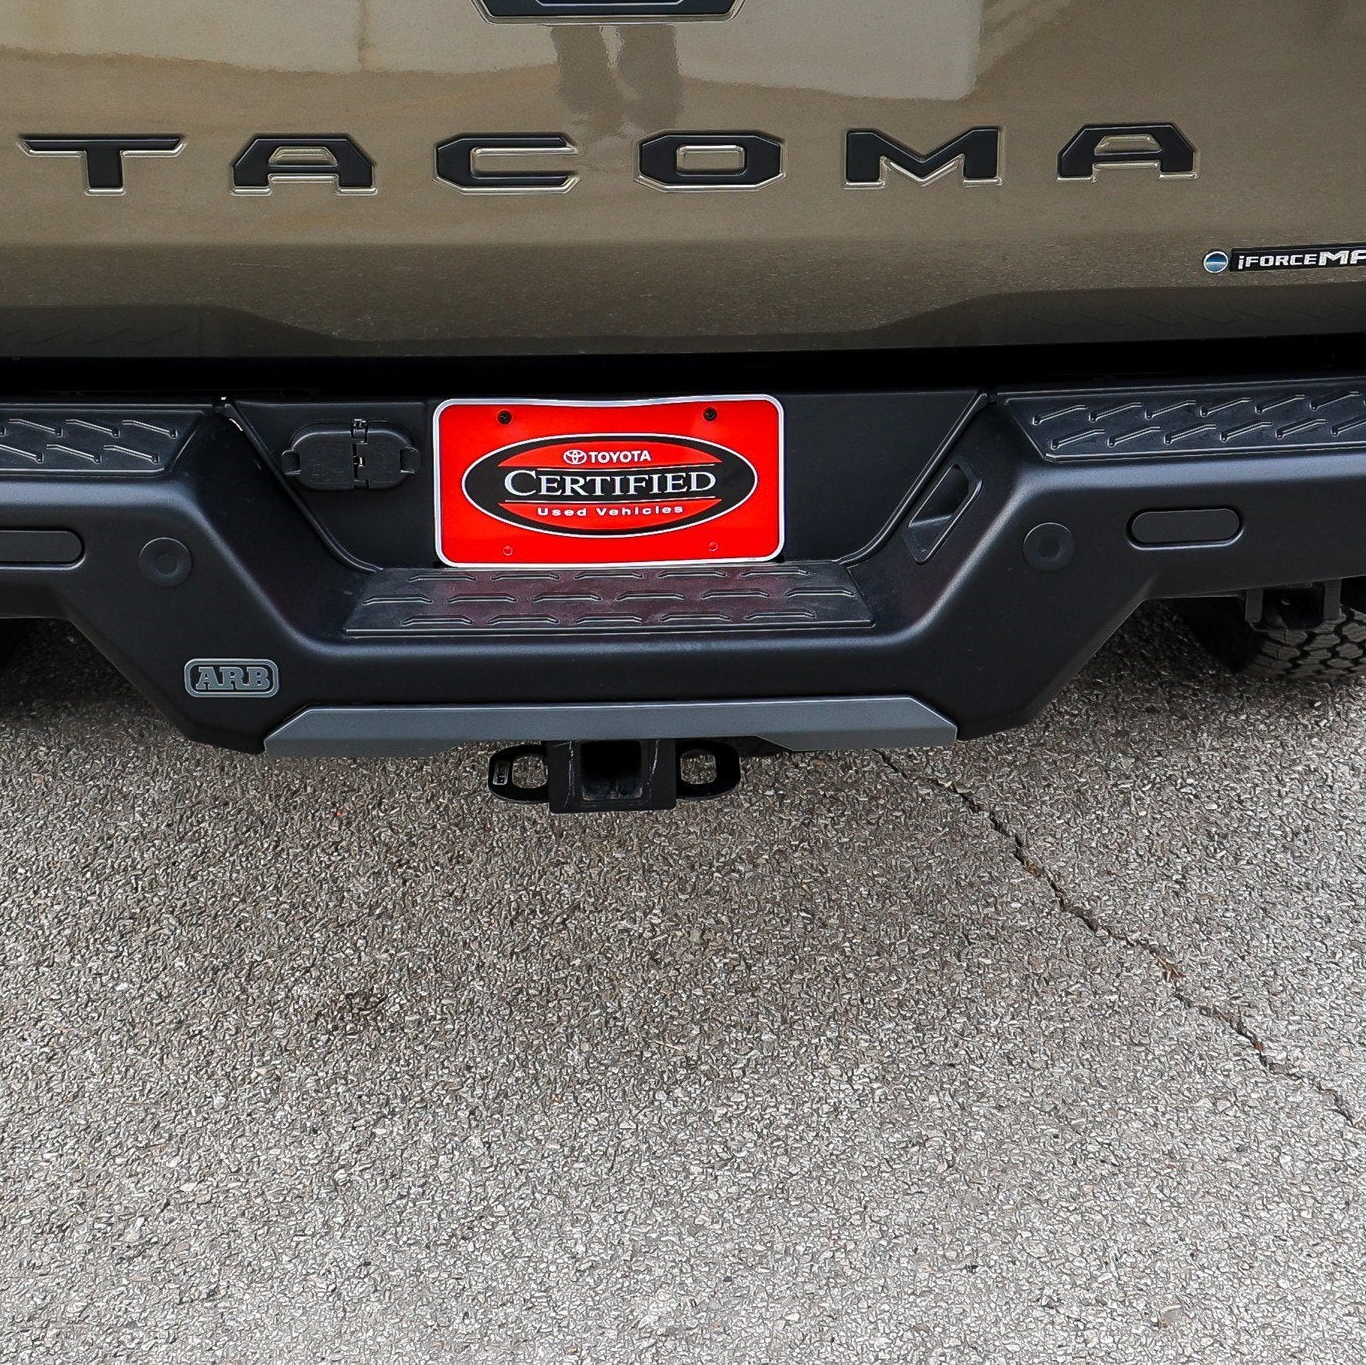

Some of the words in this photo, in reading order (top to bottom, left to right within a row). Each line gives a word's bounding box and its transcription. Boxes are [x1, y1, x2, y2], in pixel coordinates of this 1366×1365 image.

[18, 122, 1200, 196] TACOMA
[590, 450, 652, 464] TOYOTA
[537, 506, 587, 517] Used
[596, 505, 684, 516] Vehicles
[195, 666, 271, 690] ARB
